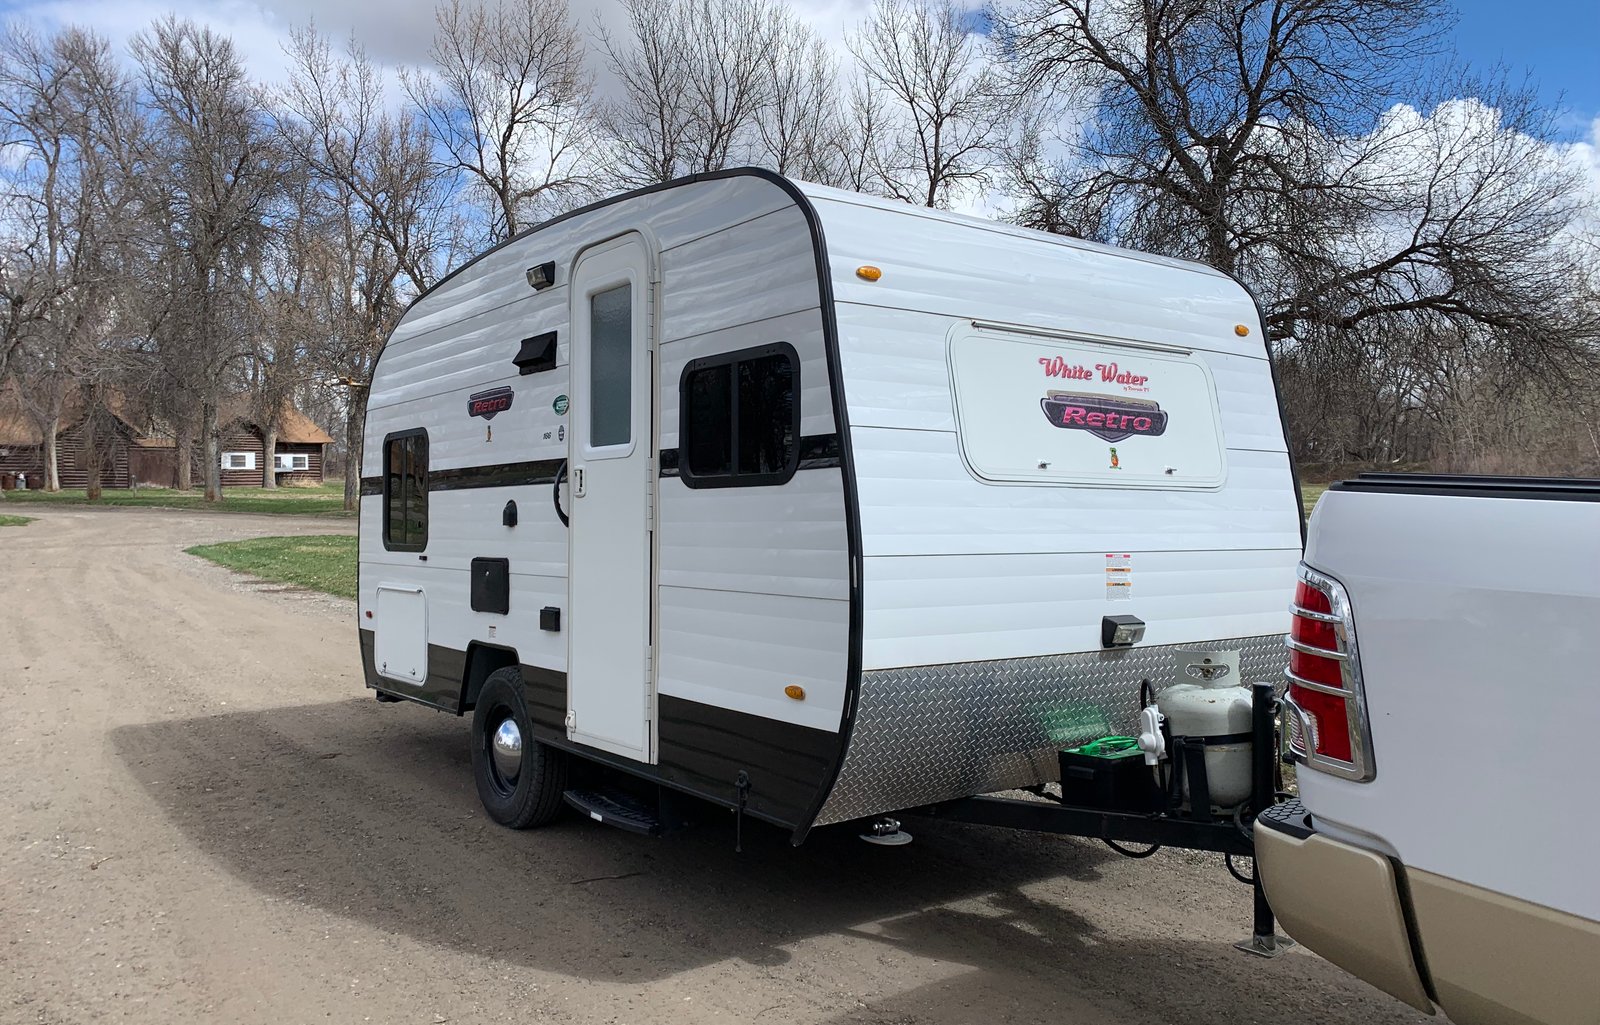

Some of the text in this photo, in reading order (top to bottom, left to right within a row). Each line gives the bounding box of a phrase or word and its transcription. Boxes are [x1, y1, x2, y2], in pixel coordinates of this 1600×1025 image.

[1039, 356, 1149, 386] White Water
[473, 398, 506, 413] Retro
[1062, 406, 1152, 431] Retro
